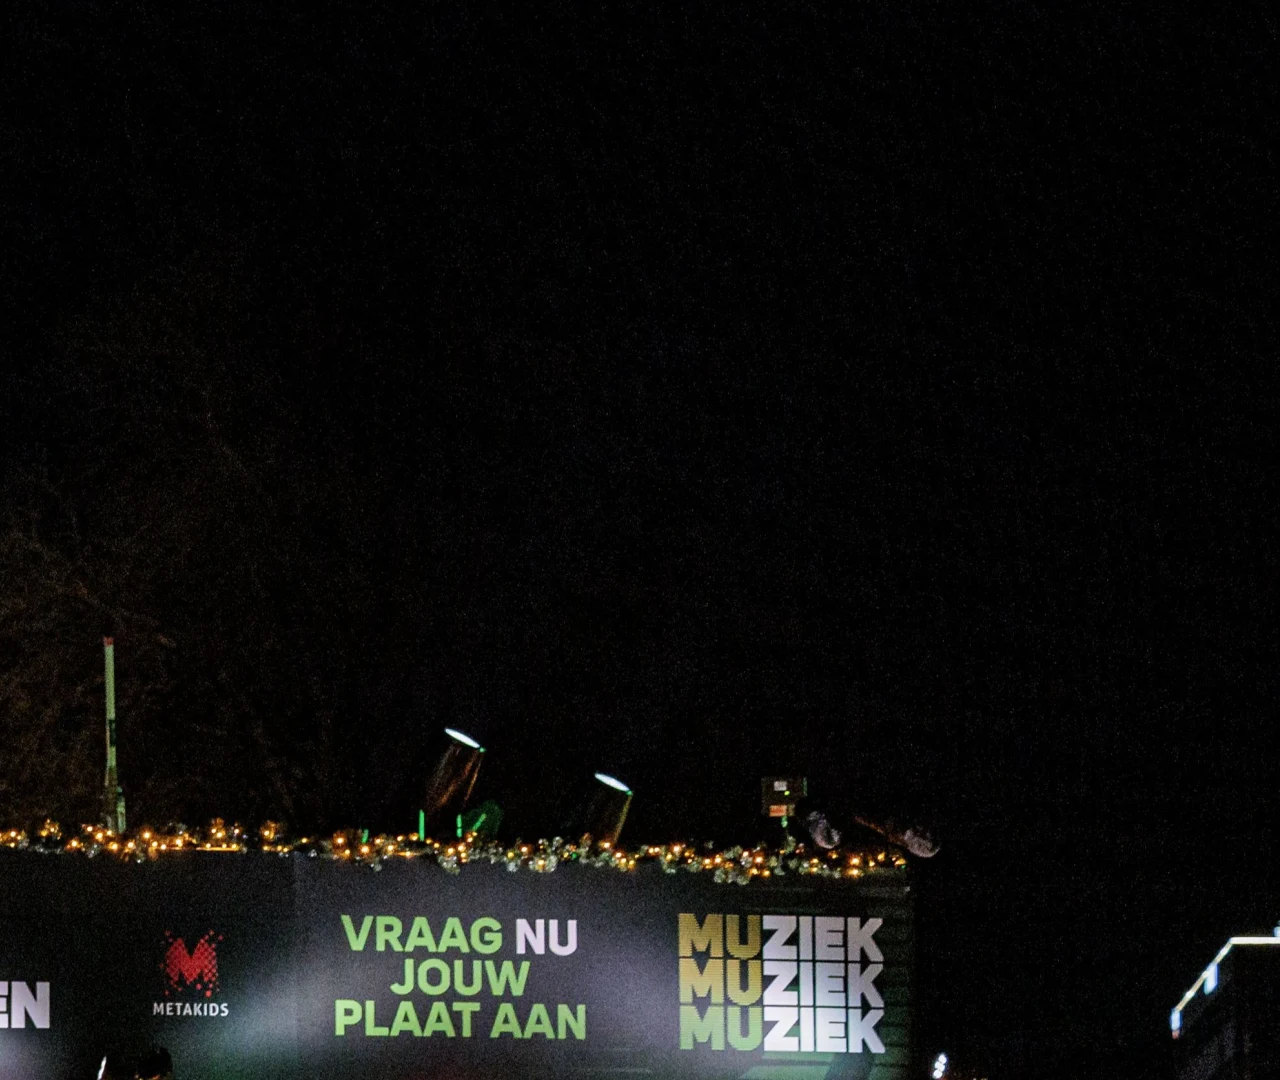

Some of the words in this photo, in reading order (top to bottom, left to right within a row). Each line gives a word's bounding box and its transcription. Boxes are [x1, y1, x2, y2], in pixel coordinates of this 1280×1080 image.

[340, 914, 503, 954] VRAAG
[515, 918, 578, 956] NU
[678, 913, 884, 963] MUZIEK
[390, 958, 530, 997] JOUW
[678, 958, 884, 1008] MUZIEK
[153, 1002, 230, 1017] METAKIDS
[334, 1000, 480, 1038] PLAAT
[489, 1002, 587, 1041] AAN
[678, 1004, 885, 1055] MUZIEK
